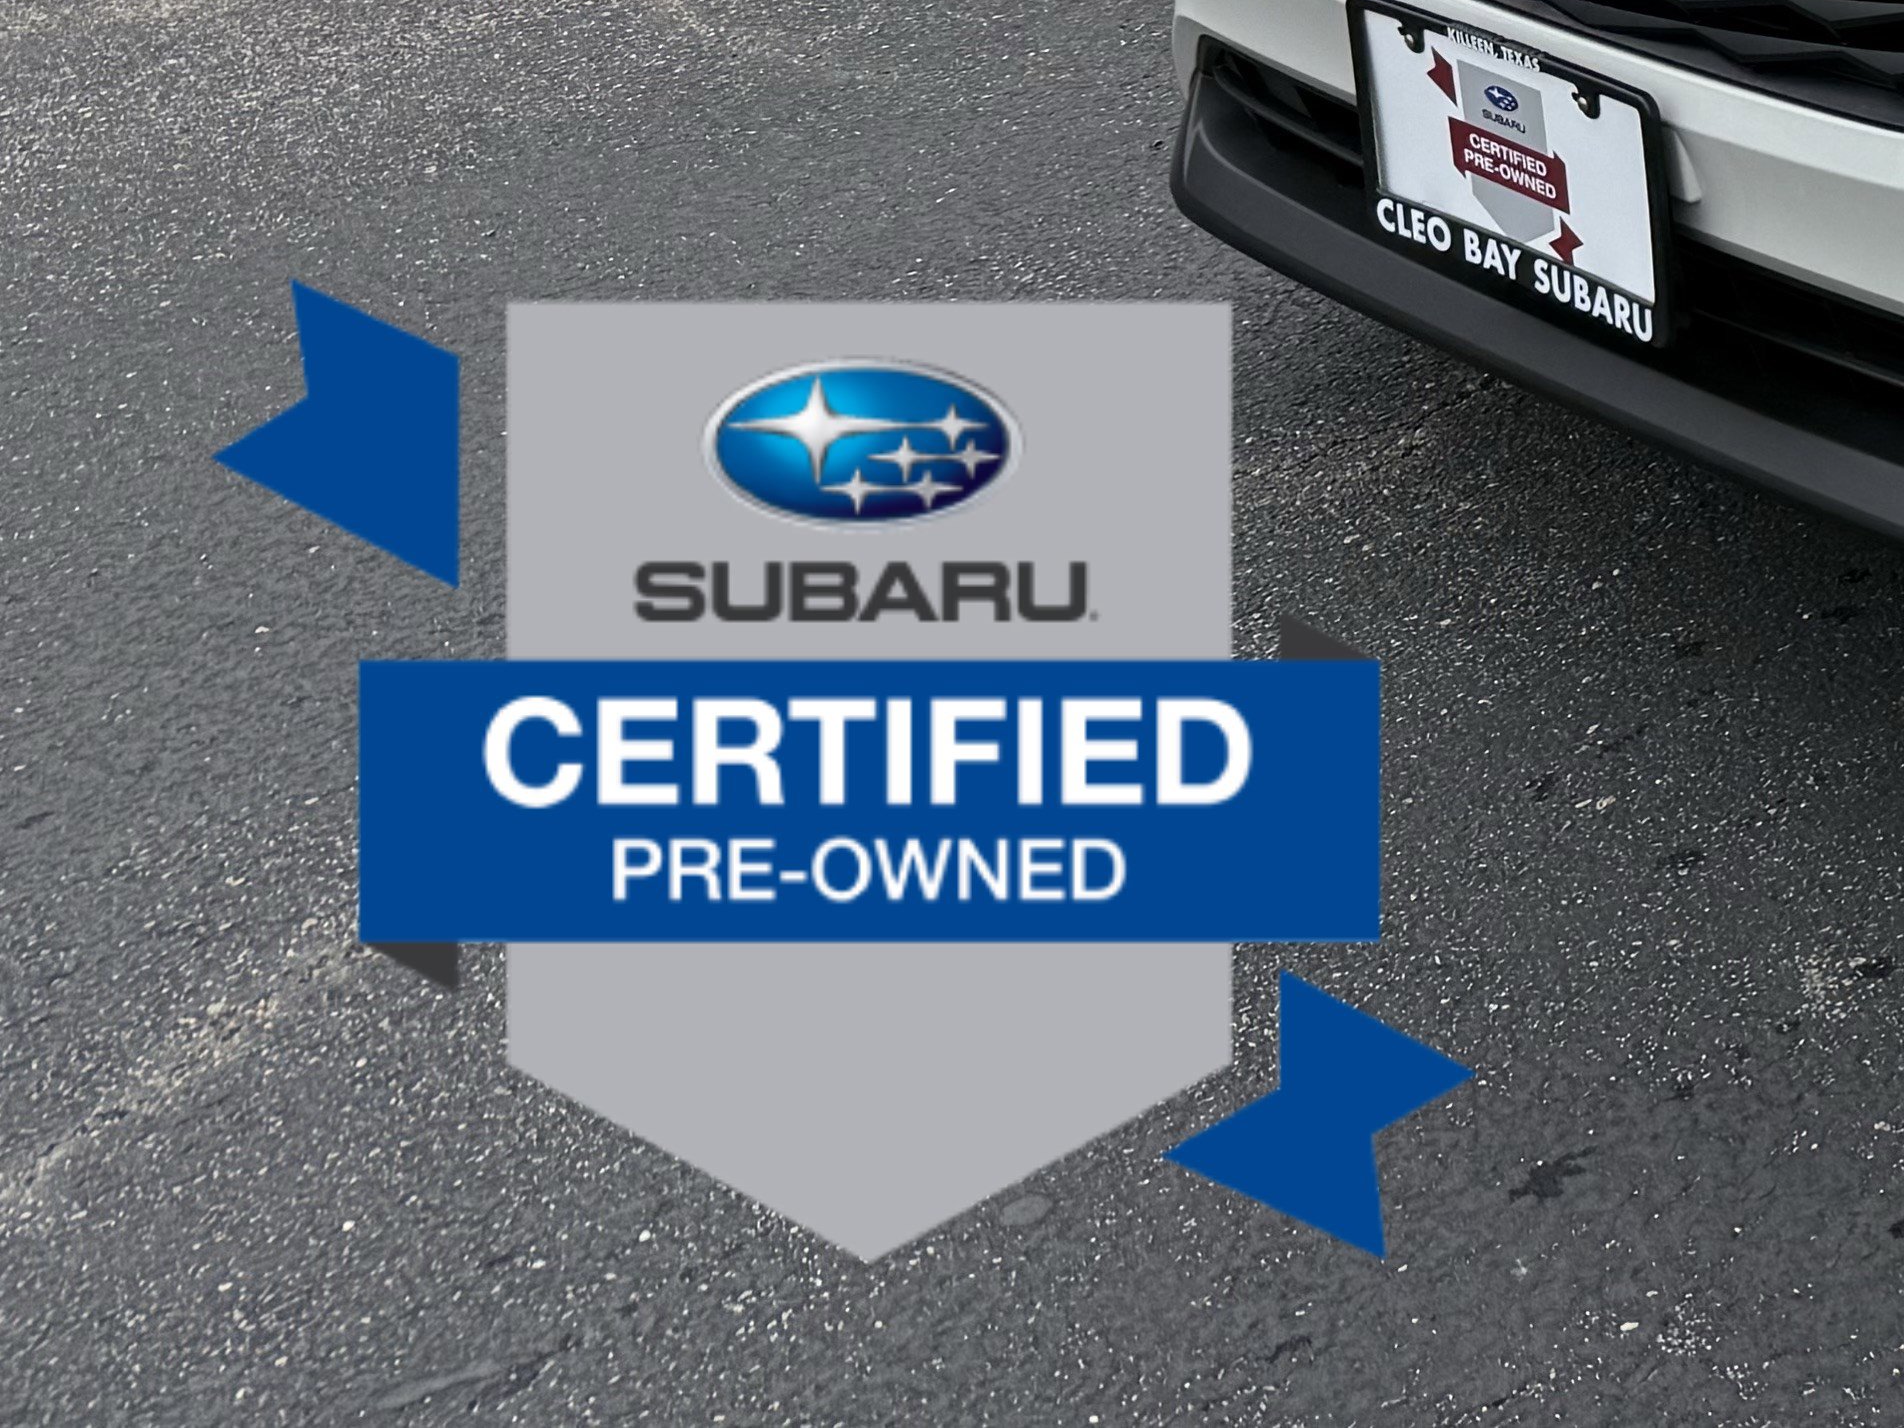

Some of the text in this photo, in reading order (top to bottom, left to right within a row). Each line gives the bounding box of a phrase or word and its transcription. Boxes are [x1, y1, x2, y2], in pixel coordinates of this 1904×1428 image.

[1500, 45, 1540, 73] TEXAS
[1482, 109, 1526, 134] SUBARU
[1463, 148, 1557, 199] PRE-OWNED
[1469, 133, 1547, 177] CERTIFIED
[1376, 197, 1652, 343] CLEO BAY SUBARU
